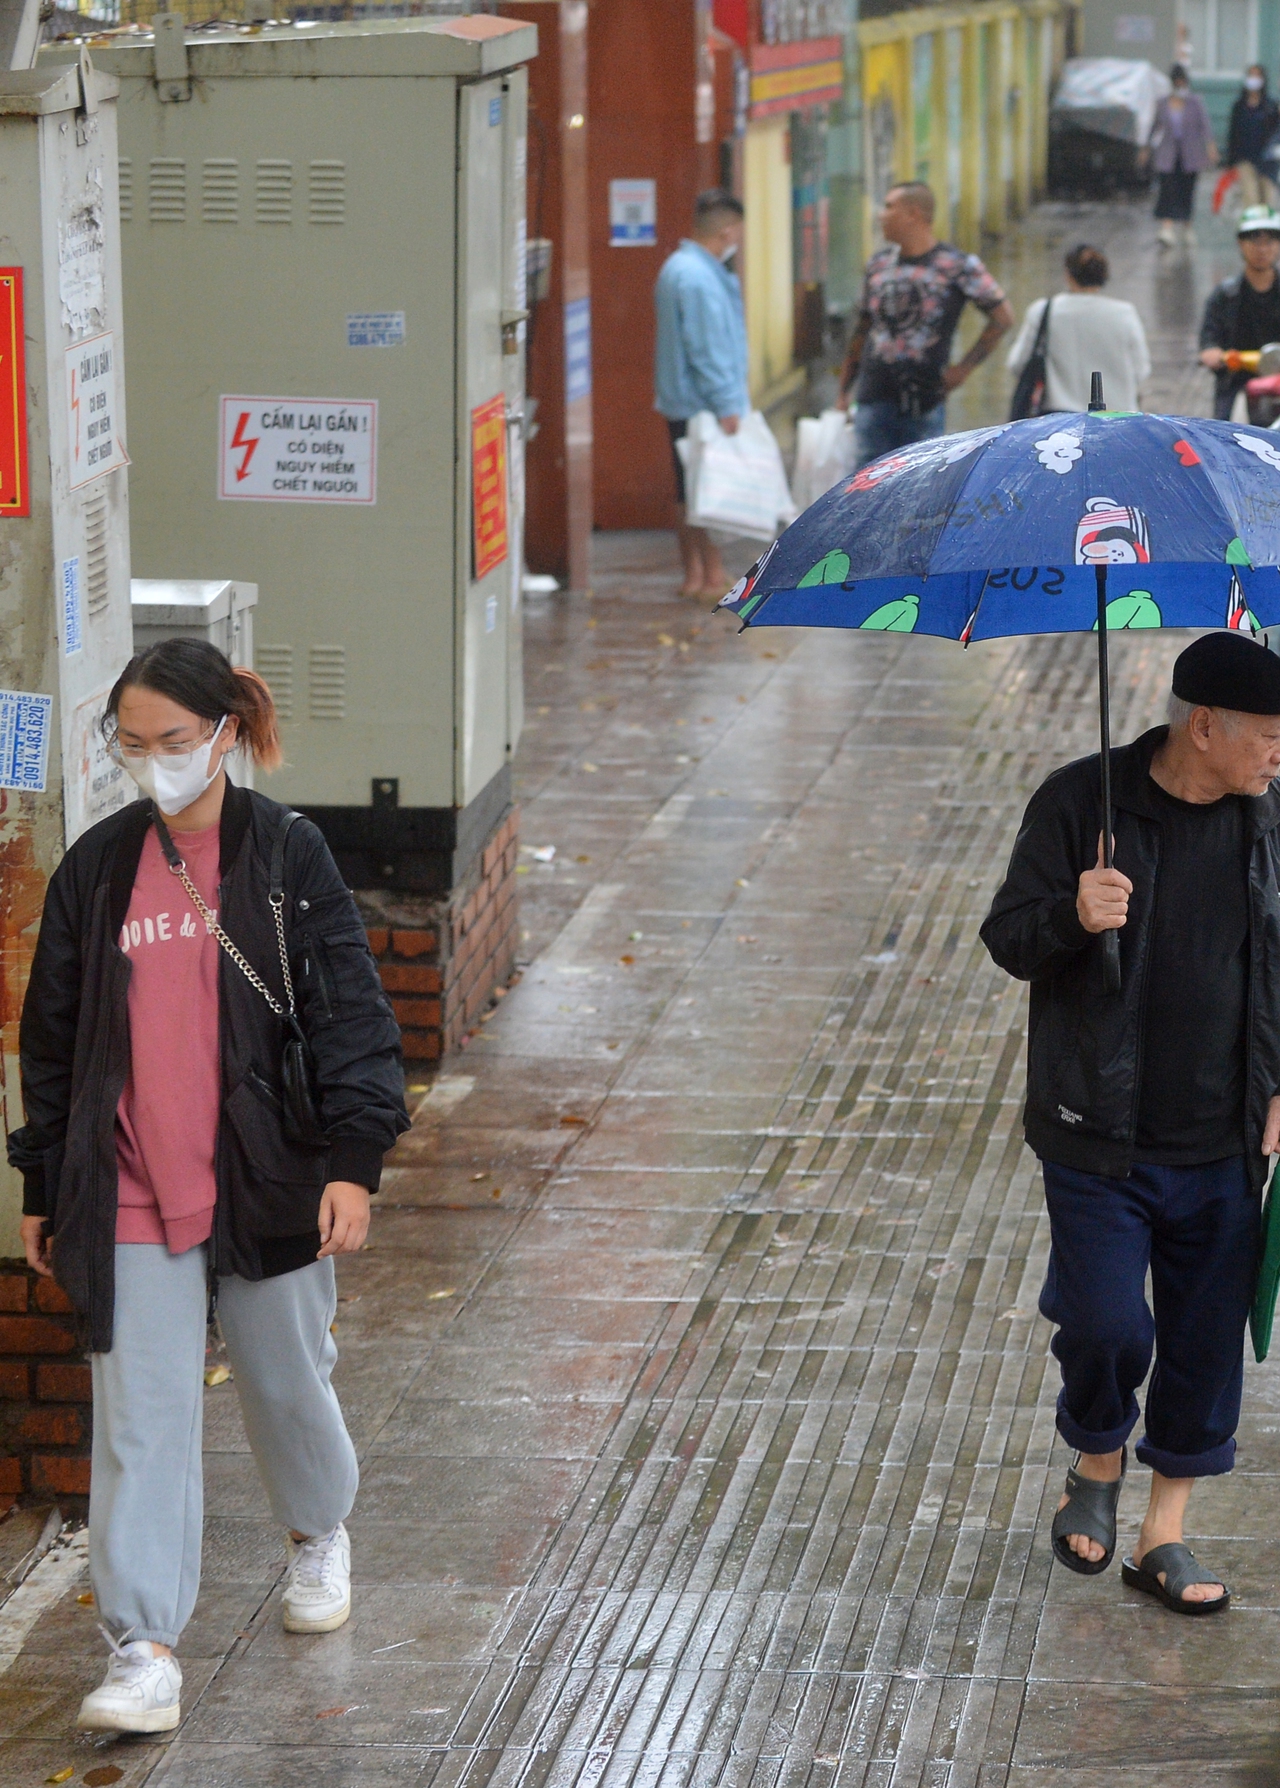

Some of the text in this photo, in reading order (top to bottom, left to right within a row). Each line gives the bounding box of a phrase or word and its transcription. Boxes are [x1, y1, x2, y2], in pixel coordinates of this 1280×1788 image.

[300, 413, 322, 436] LẠI
[276, 460, 316, 473] NGUY
[24, 706, 44, 780] 0914.483.620
[121, 912, 172, 953] JOIE
[180, 912, 196, 937] de
